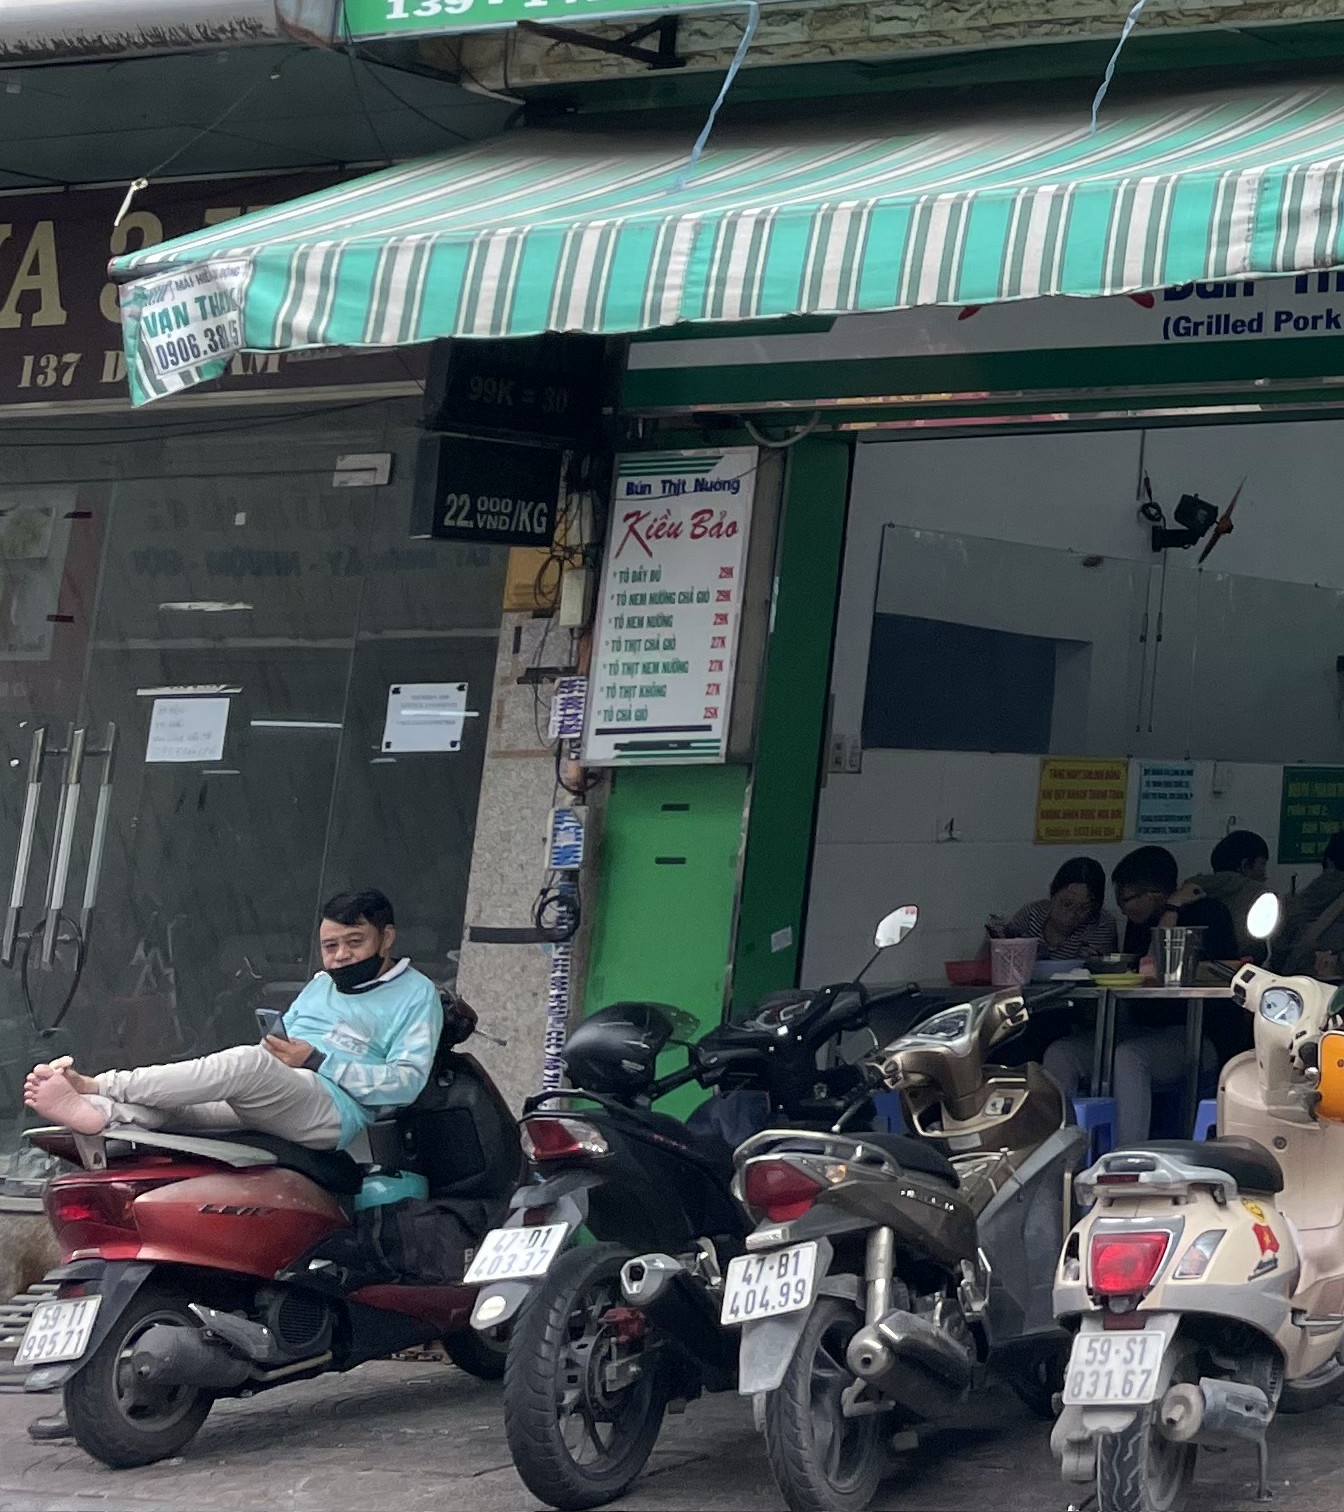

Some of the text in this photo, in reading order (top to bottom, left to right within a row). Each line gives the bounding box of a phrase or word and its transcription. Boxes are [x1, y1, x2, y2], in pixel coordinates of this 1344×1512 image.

[1162, 306, 1263, 341] (Grilled
[1274, 306, 1341, 334] Pork
[18, 352, 83, 388] 137
[476, 513, 510, 530] VND
[615, 509, 739, 559] Kiều Bảo
[473, 1250, 549, 1278] 403.37
[729, 1279, 807, 1317] 404.99
[22, 1328, 85, 1359] 995.71
[1071, 1368, 1153, 1399] 831.67
